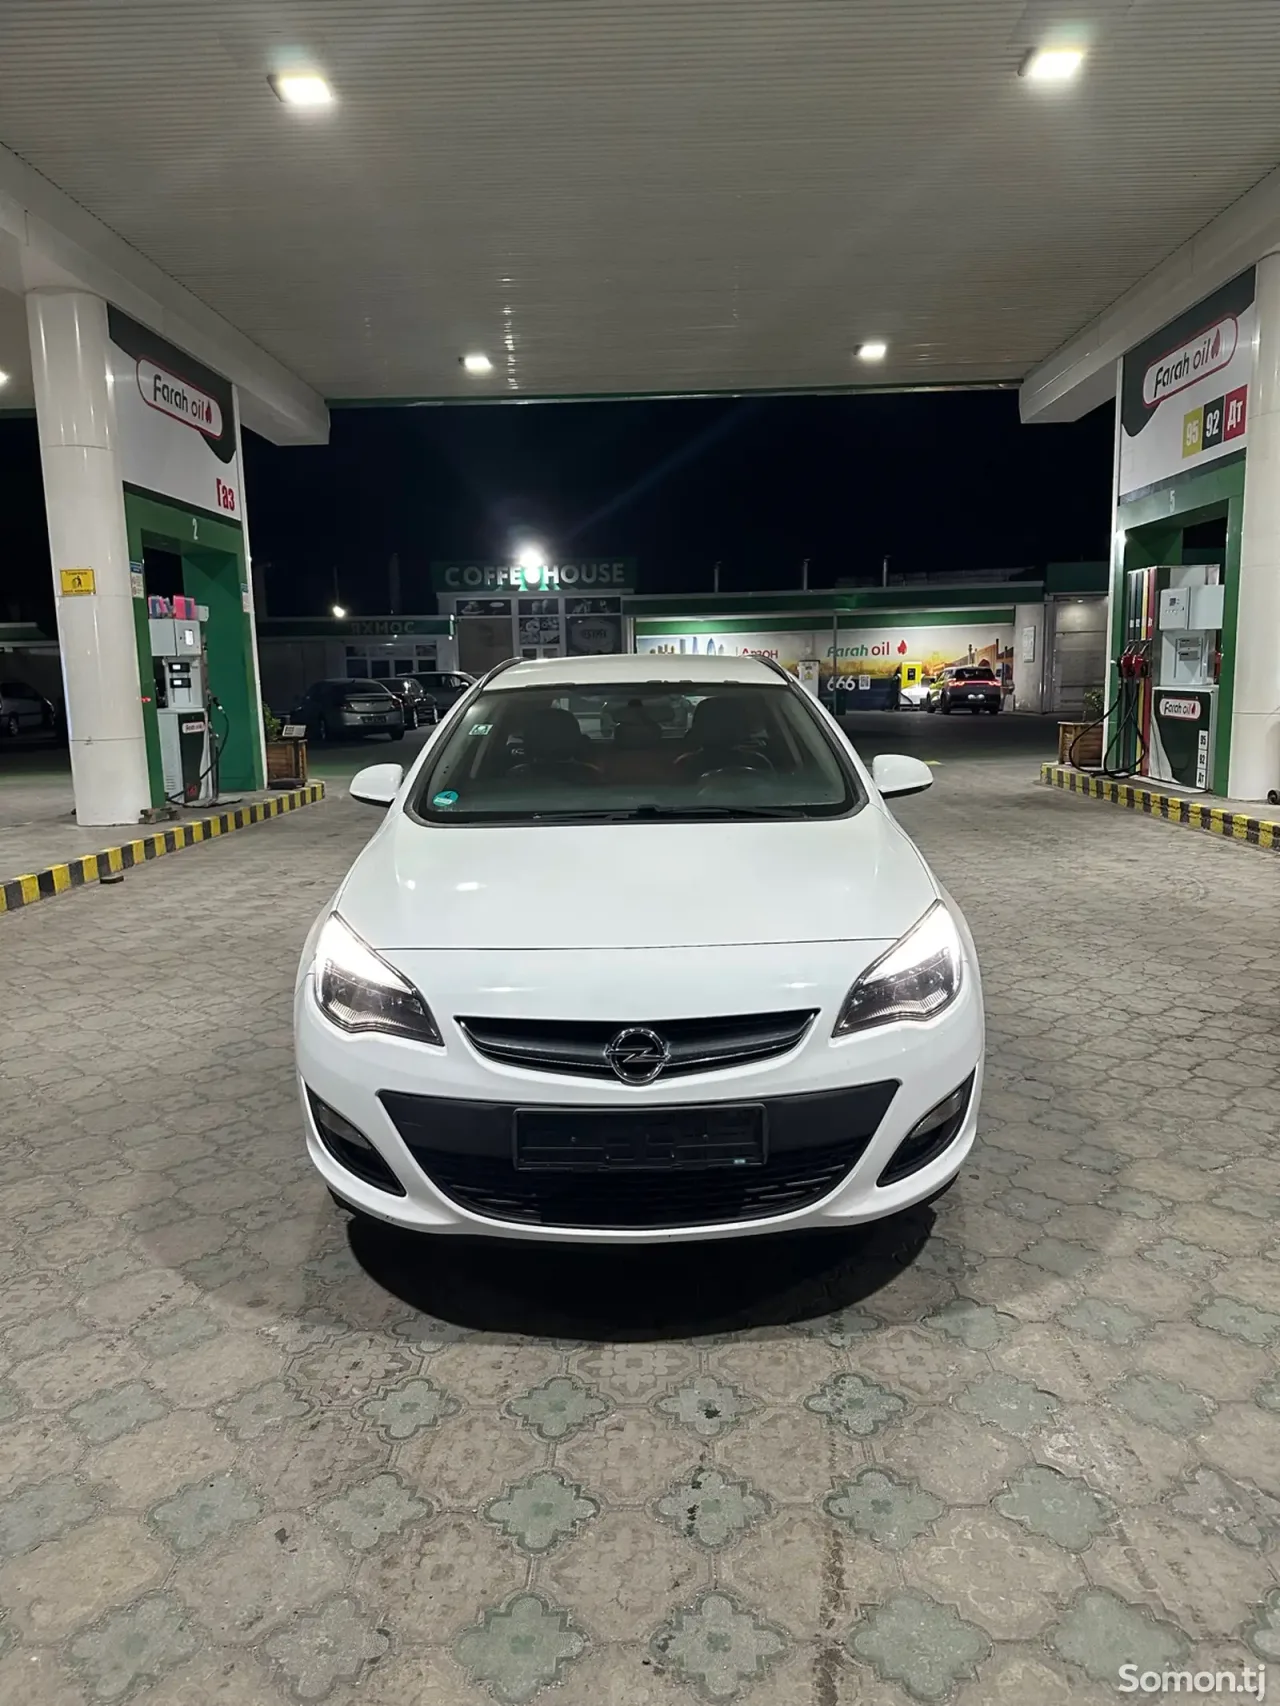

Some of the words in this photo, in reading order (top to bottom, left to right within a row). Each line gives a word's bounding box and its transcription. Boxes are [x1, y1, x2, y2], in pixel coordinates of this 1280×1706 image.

[1154, 351, 1190, 398] Farah
[1193, 337, 1211, 373] oil
[153, 374, 189, 413] Farah
[191, 397, 205, 422] oil
[1186, 418, 1199, 447] 95
[1206, 409, 1220, 438] 92
[216, 477, 236, 512] Газ
[1169, 490, 1176, 513] 5
[192, 517, 199, 540] 2
[445, 565, 536, 586] COFFE
[543, 562, 625, 585] HOUSE
[827, 644, 868, 658] Farah
[872, 641, 890, 656] oil
[827, 674, 856, 692] 666
